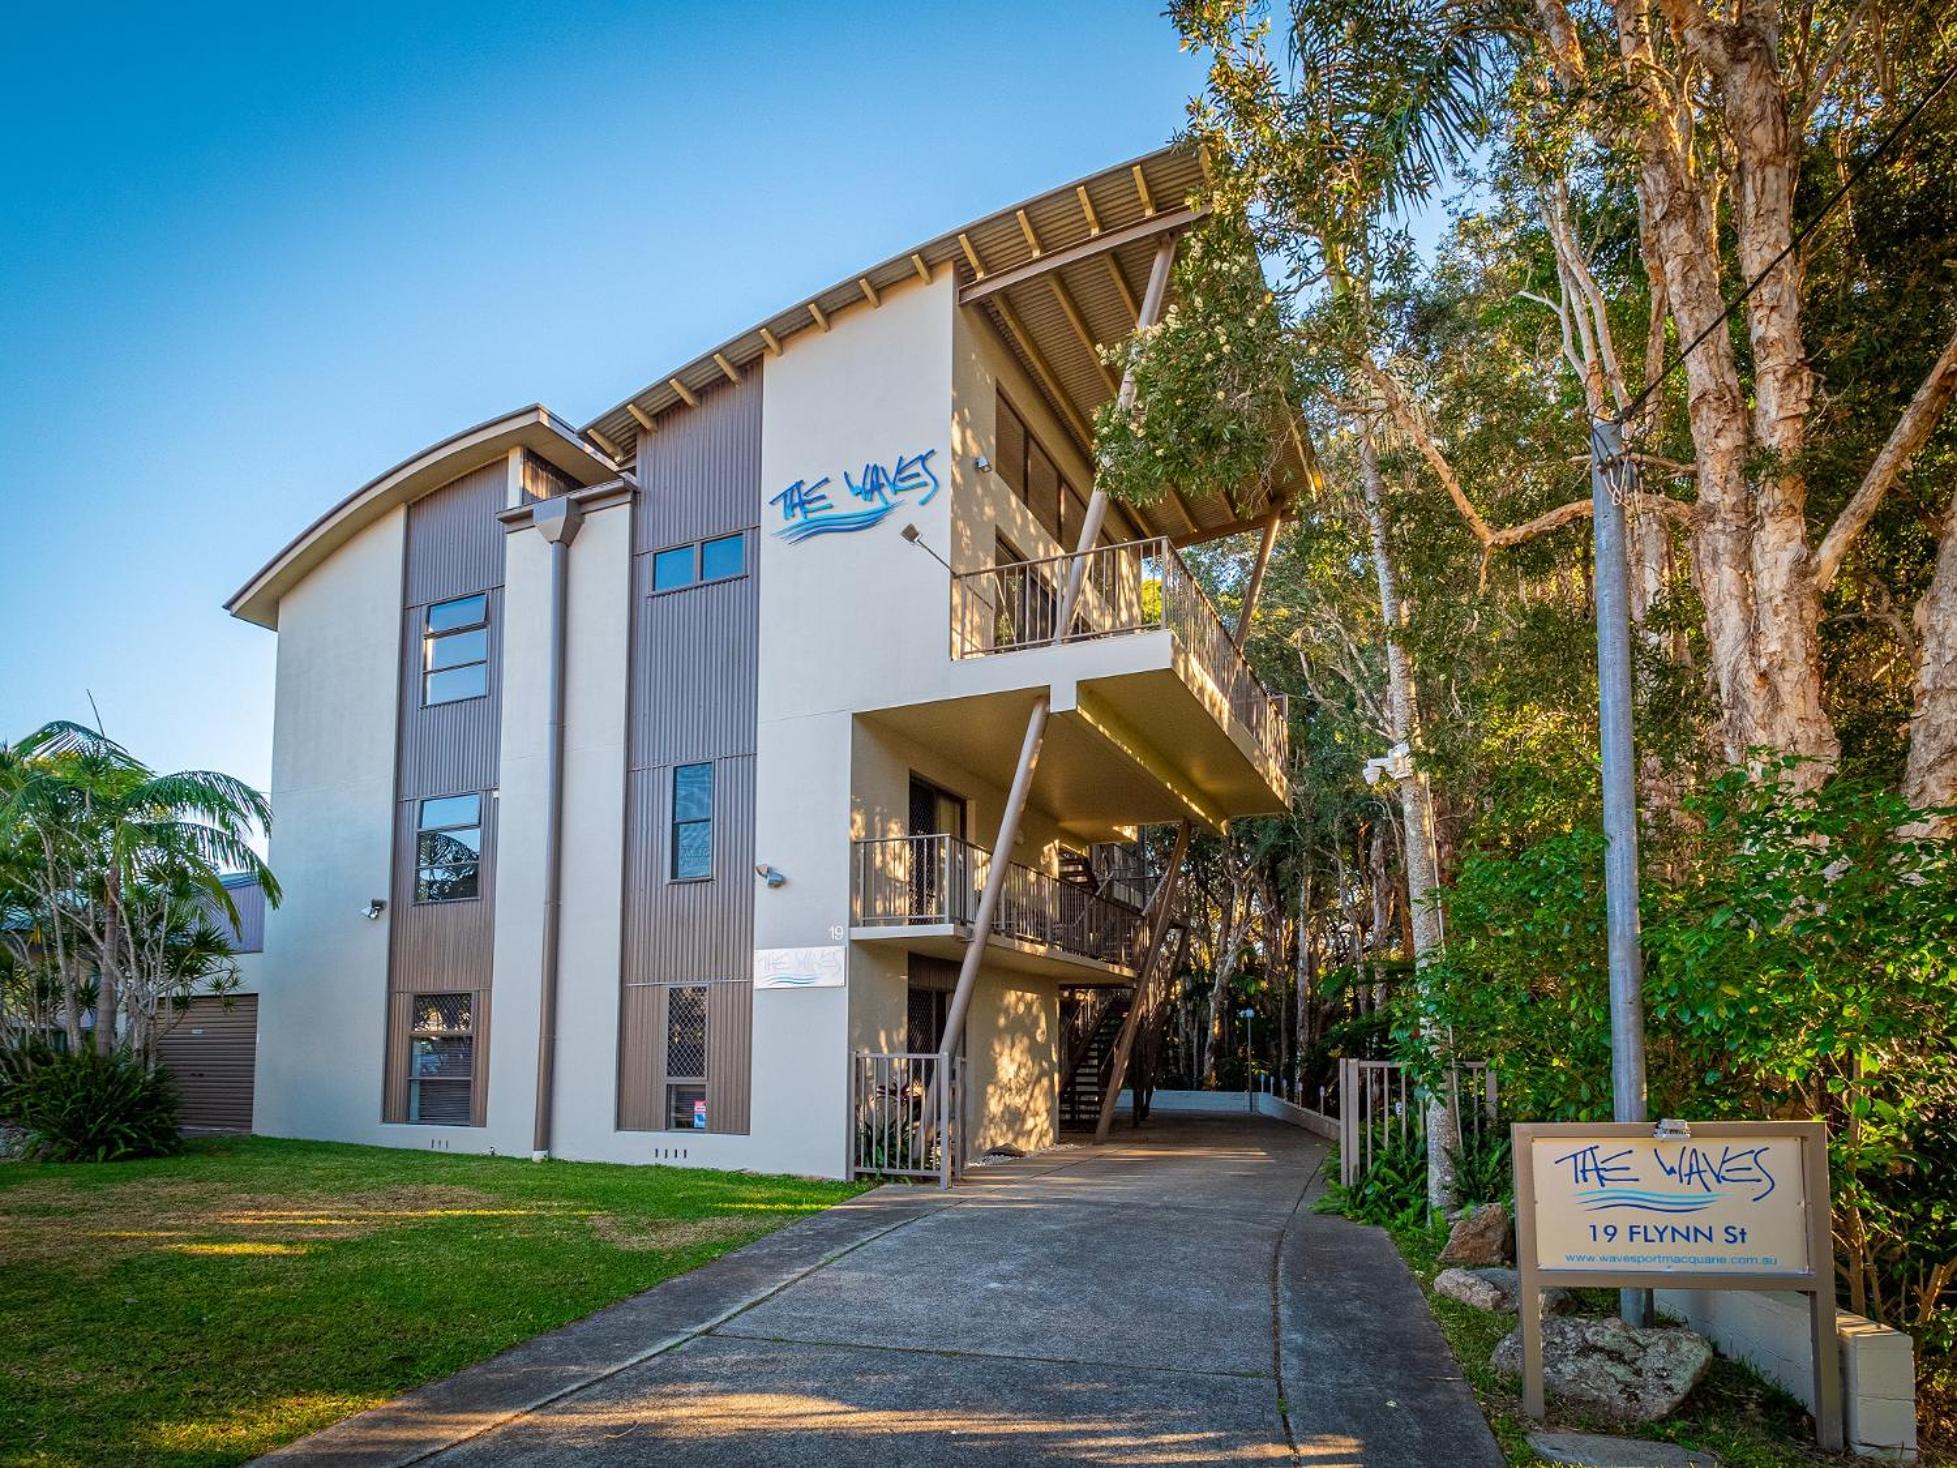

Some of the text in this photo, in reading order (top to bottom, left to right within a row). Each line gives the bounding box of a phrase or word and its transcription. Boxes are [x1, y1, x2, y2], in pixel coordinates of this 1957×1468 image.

[769, 449, 940, 521] THE WAVES
[828, 925, 844, 941] 19
[1555, 1145, 1776, 1202] THE WAVES
[1589, 1224, 1748, 1244] 19 FLYNN St
